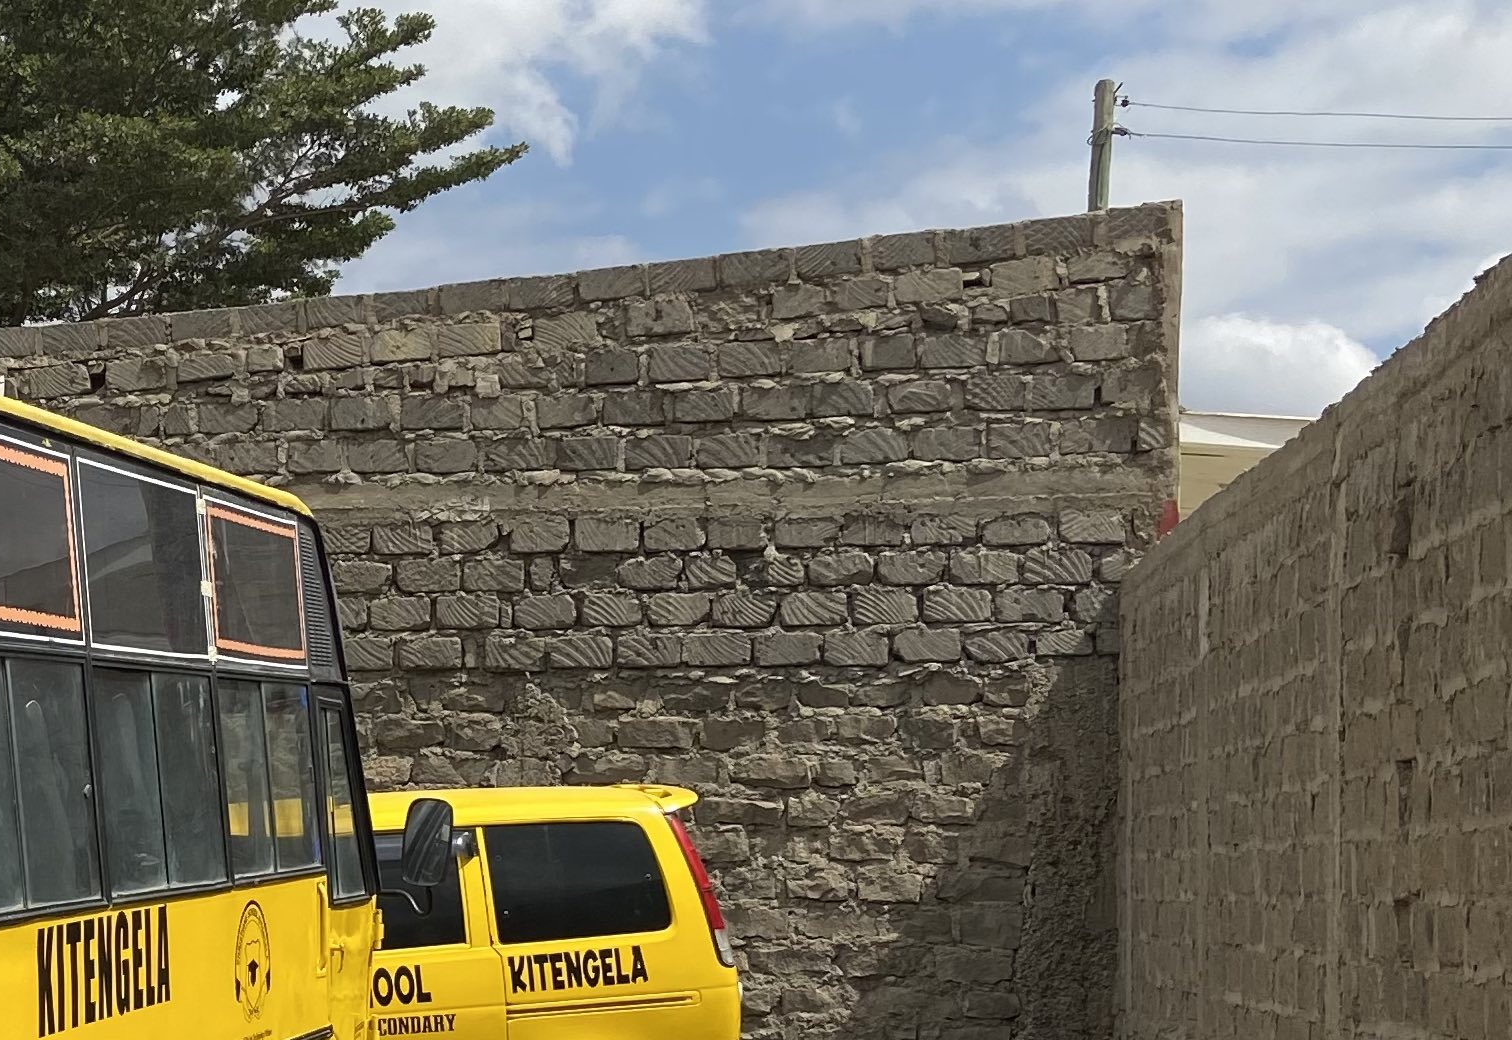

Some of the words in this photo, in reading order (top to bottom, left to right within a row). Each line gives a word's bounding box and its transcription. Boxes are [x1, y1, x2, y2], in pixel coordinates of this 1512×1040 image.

[37, 904, 172, 1038] KITENGELA
[370, 964, 432, 1008] OOL
[508, 945, 649, 994] KITENGELA
